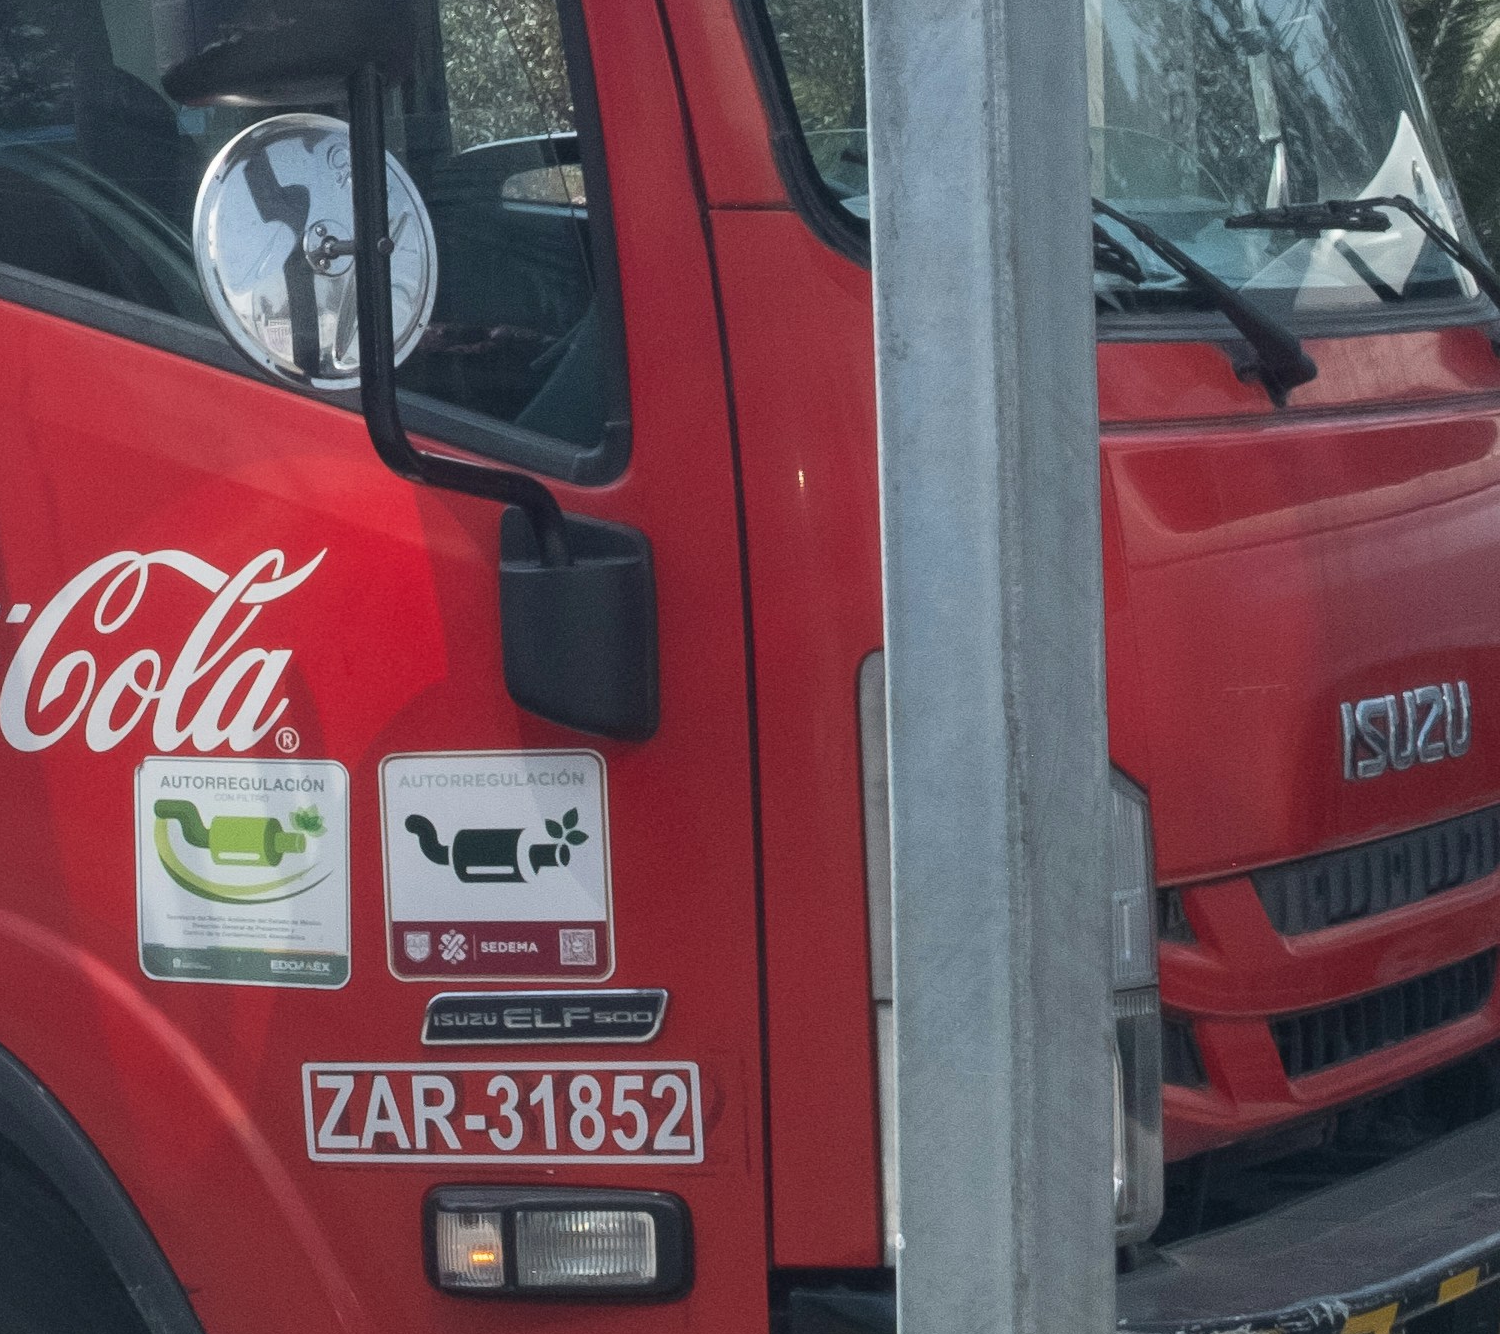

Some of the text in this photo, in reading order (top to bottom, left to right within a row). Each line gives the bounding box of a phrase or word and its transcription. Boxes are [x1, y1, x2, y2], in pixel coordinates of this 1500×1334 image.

[1340, 679, 1472, 781] ISUZU
[160, 773, 325, 794] AUTORREGULACIÓN
[399, 769, 586, 788] AUTORREGULACIÓN
[480, 940, 539, 956] SEDEMA
[433, 1006, 653, 1030] ISUZU ELF 500
[315, 1073, 692, 1153] ZAR-31852
